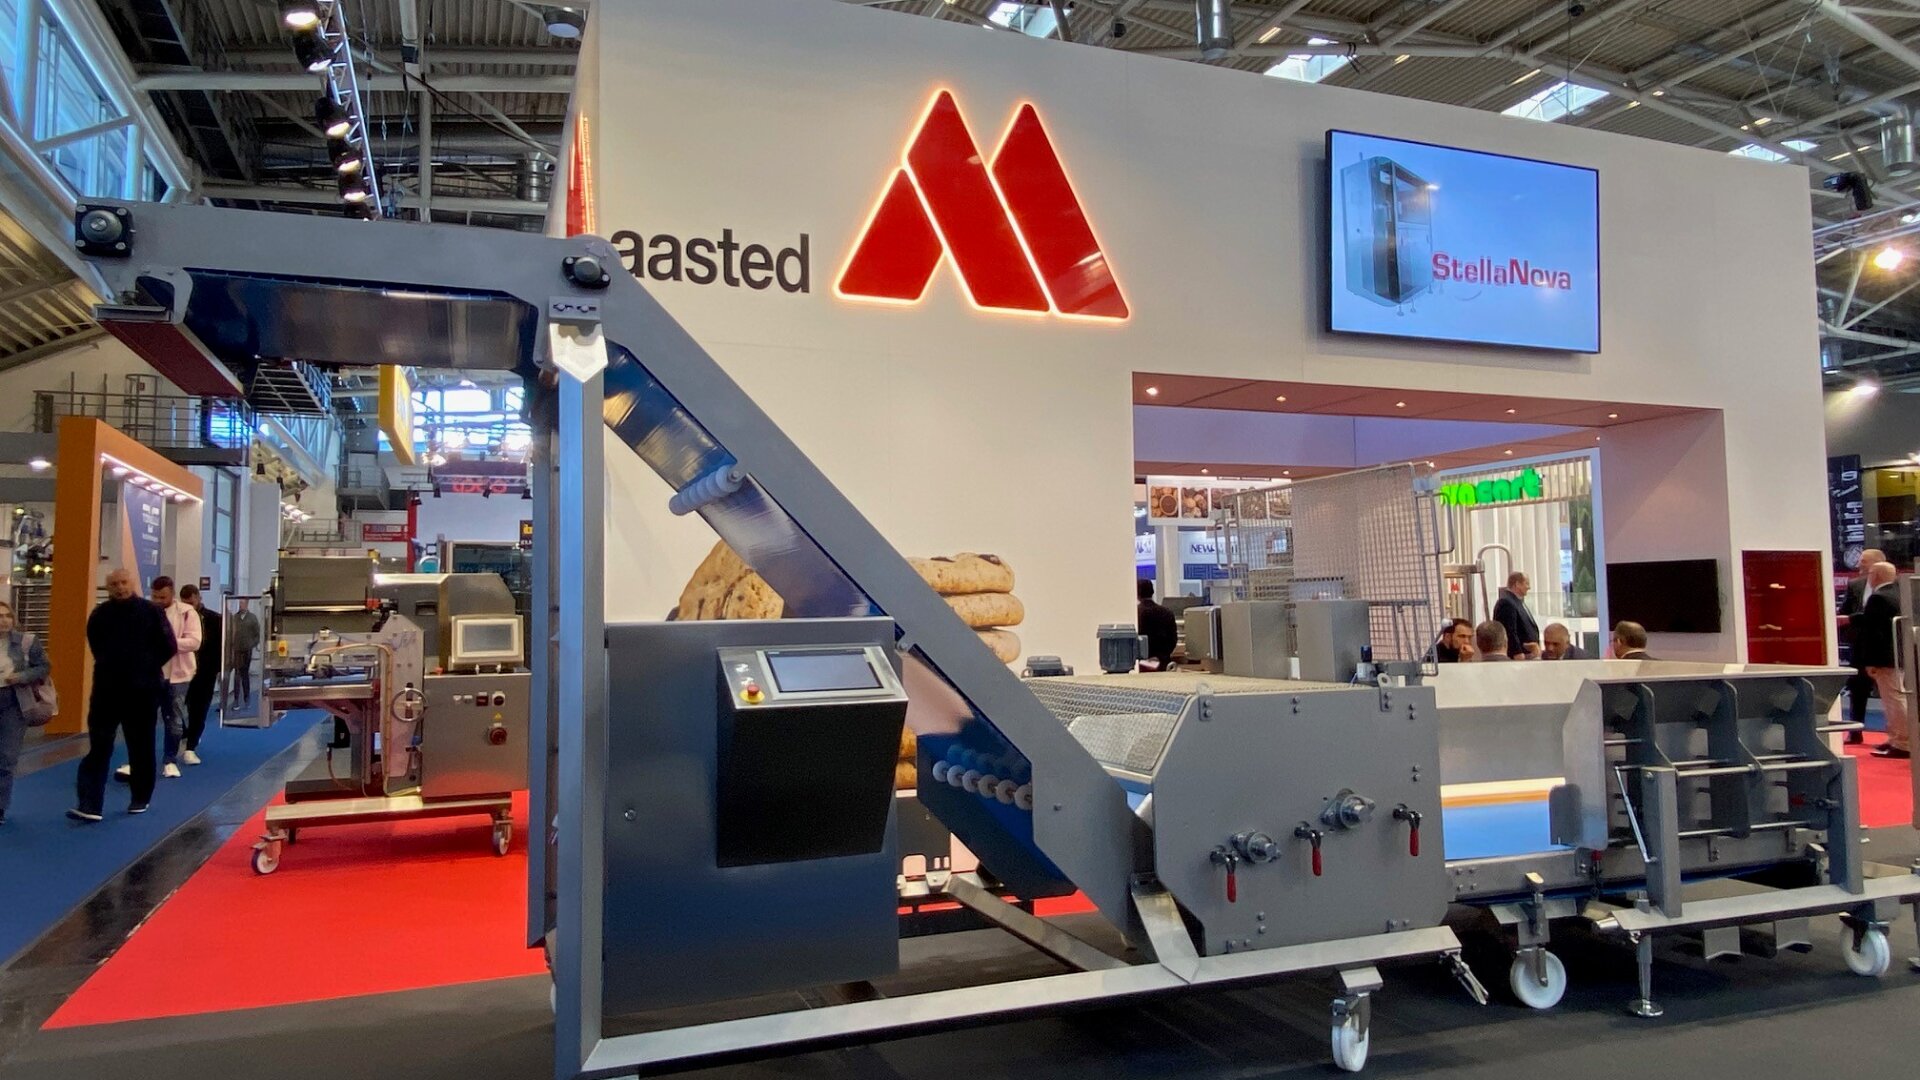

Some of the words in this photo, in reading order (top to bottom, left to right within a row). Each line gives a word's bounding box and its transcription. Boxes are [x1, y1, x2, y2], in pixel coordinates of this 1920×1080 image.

[610, 228, 810, 293] aasted
[1432, 252, 1572, 290] StellaNova
[1441, 468, 1542, 507] vacart
